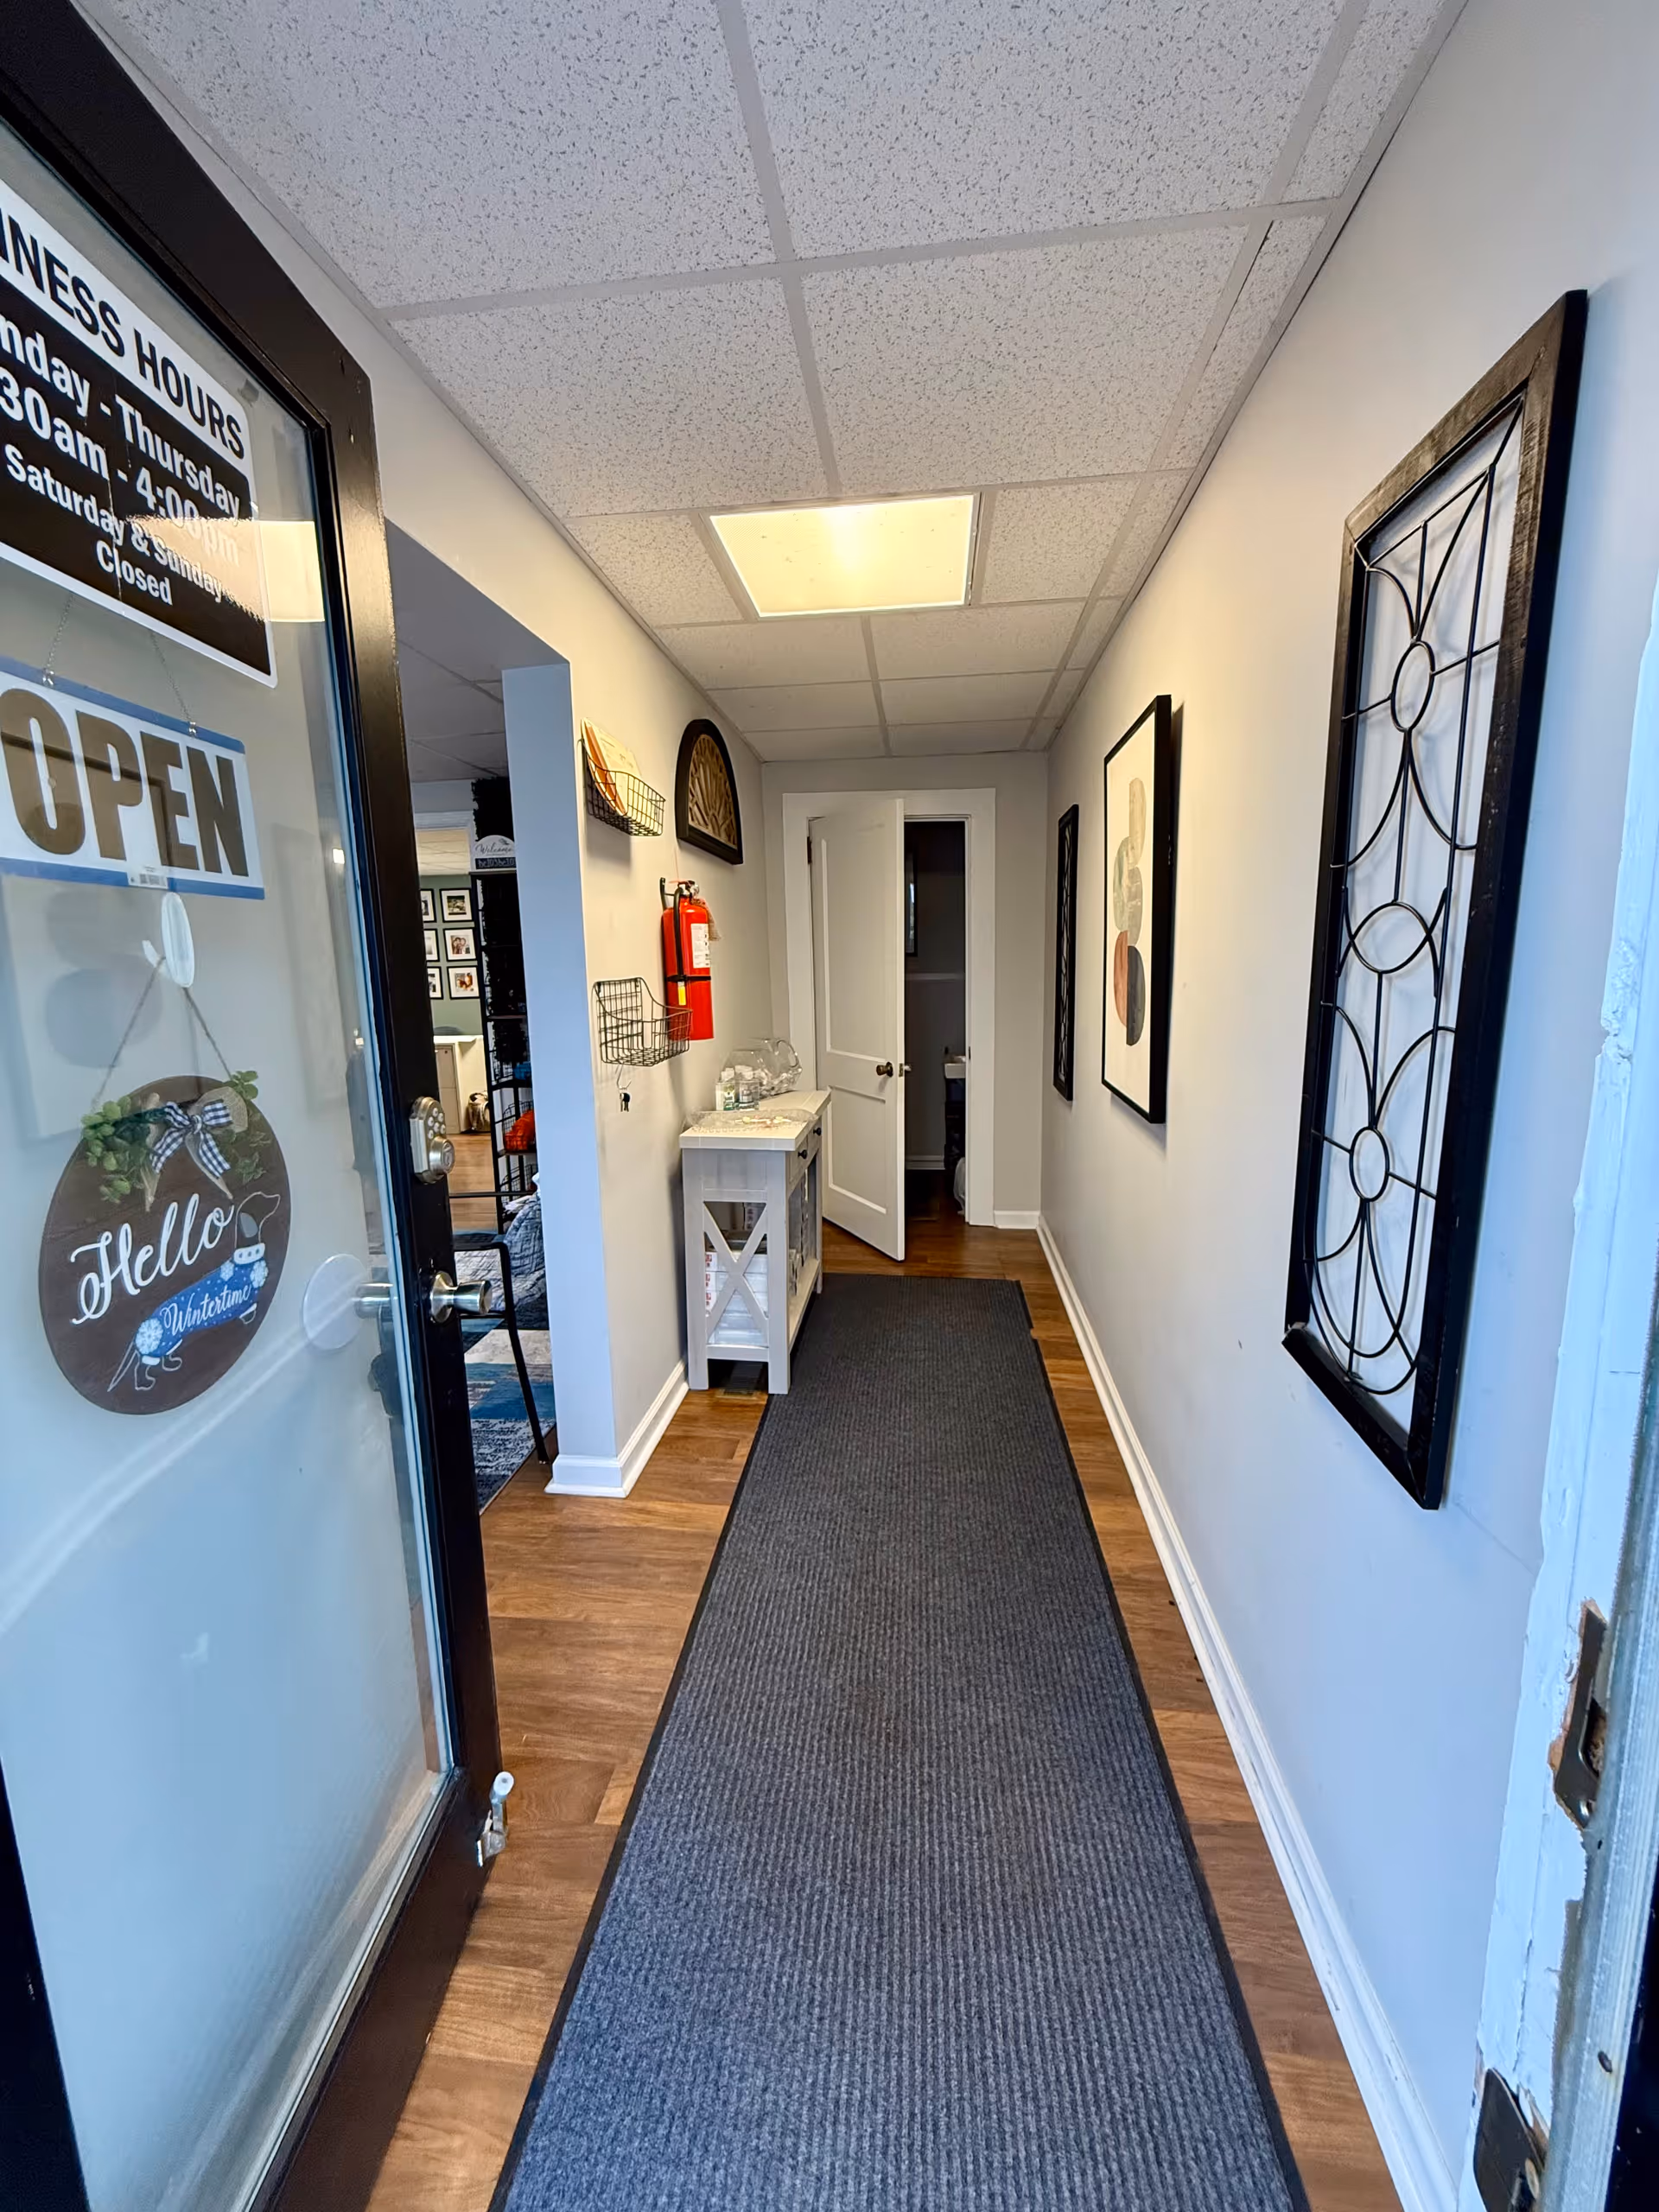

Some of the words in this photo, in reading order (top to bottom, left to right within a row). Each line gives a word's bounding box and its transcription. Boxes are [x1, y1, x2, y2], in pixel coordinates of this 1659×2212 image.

[133, 327, 245, 460] HOURS
[5, 443, 125, 546] Saturday
[130, 522, 150, 556] &
[152, 534, 223, 603] Sunday
[99, 401, 111, 416] -
[115, 394, 240, 525] Thursday
[118, 469, 128, 482] -
[136, 467, 239, 568] 4:00pm
[96, 540, 174, 606] Closed
[0, 689, 250, 877] OPEN
[69, 1193, 235, 1325] Hello
[162, 1284, 252, 1337] Wintertime
